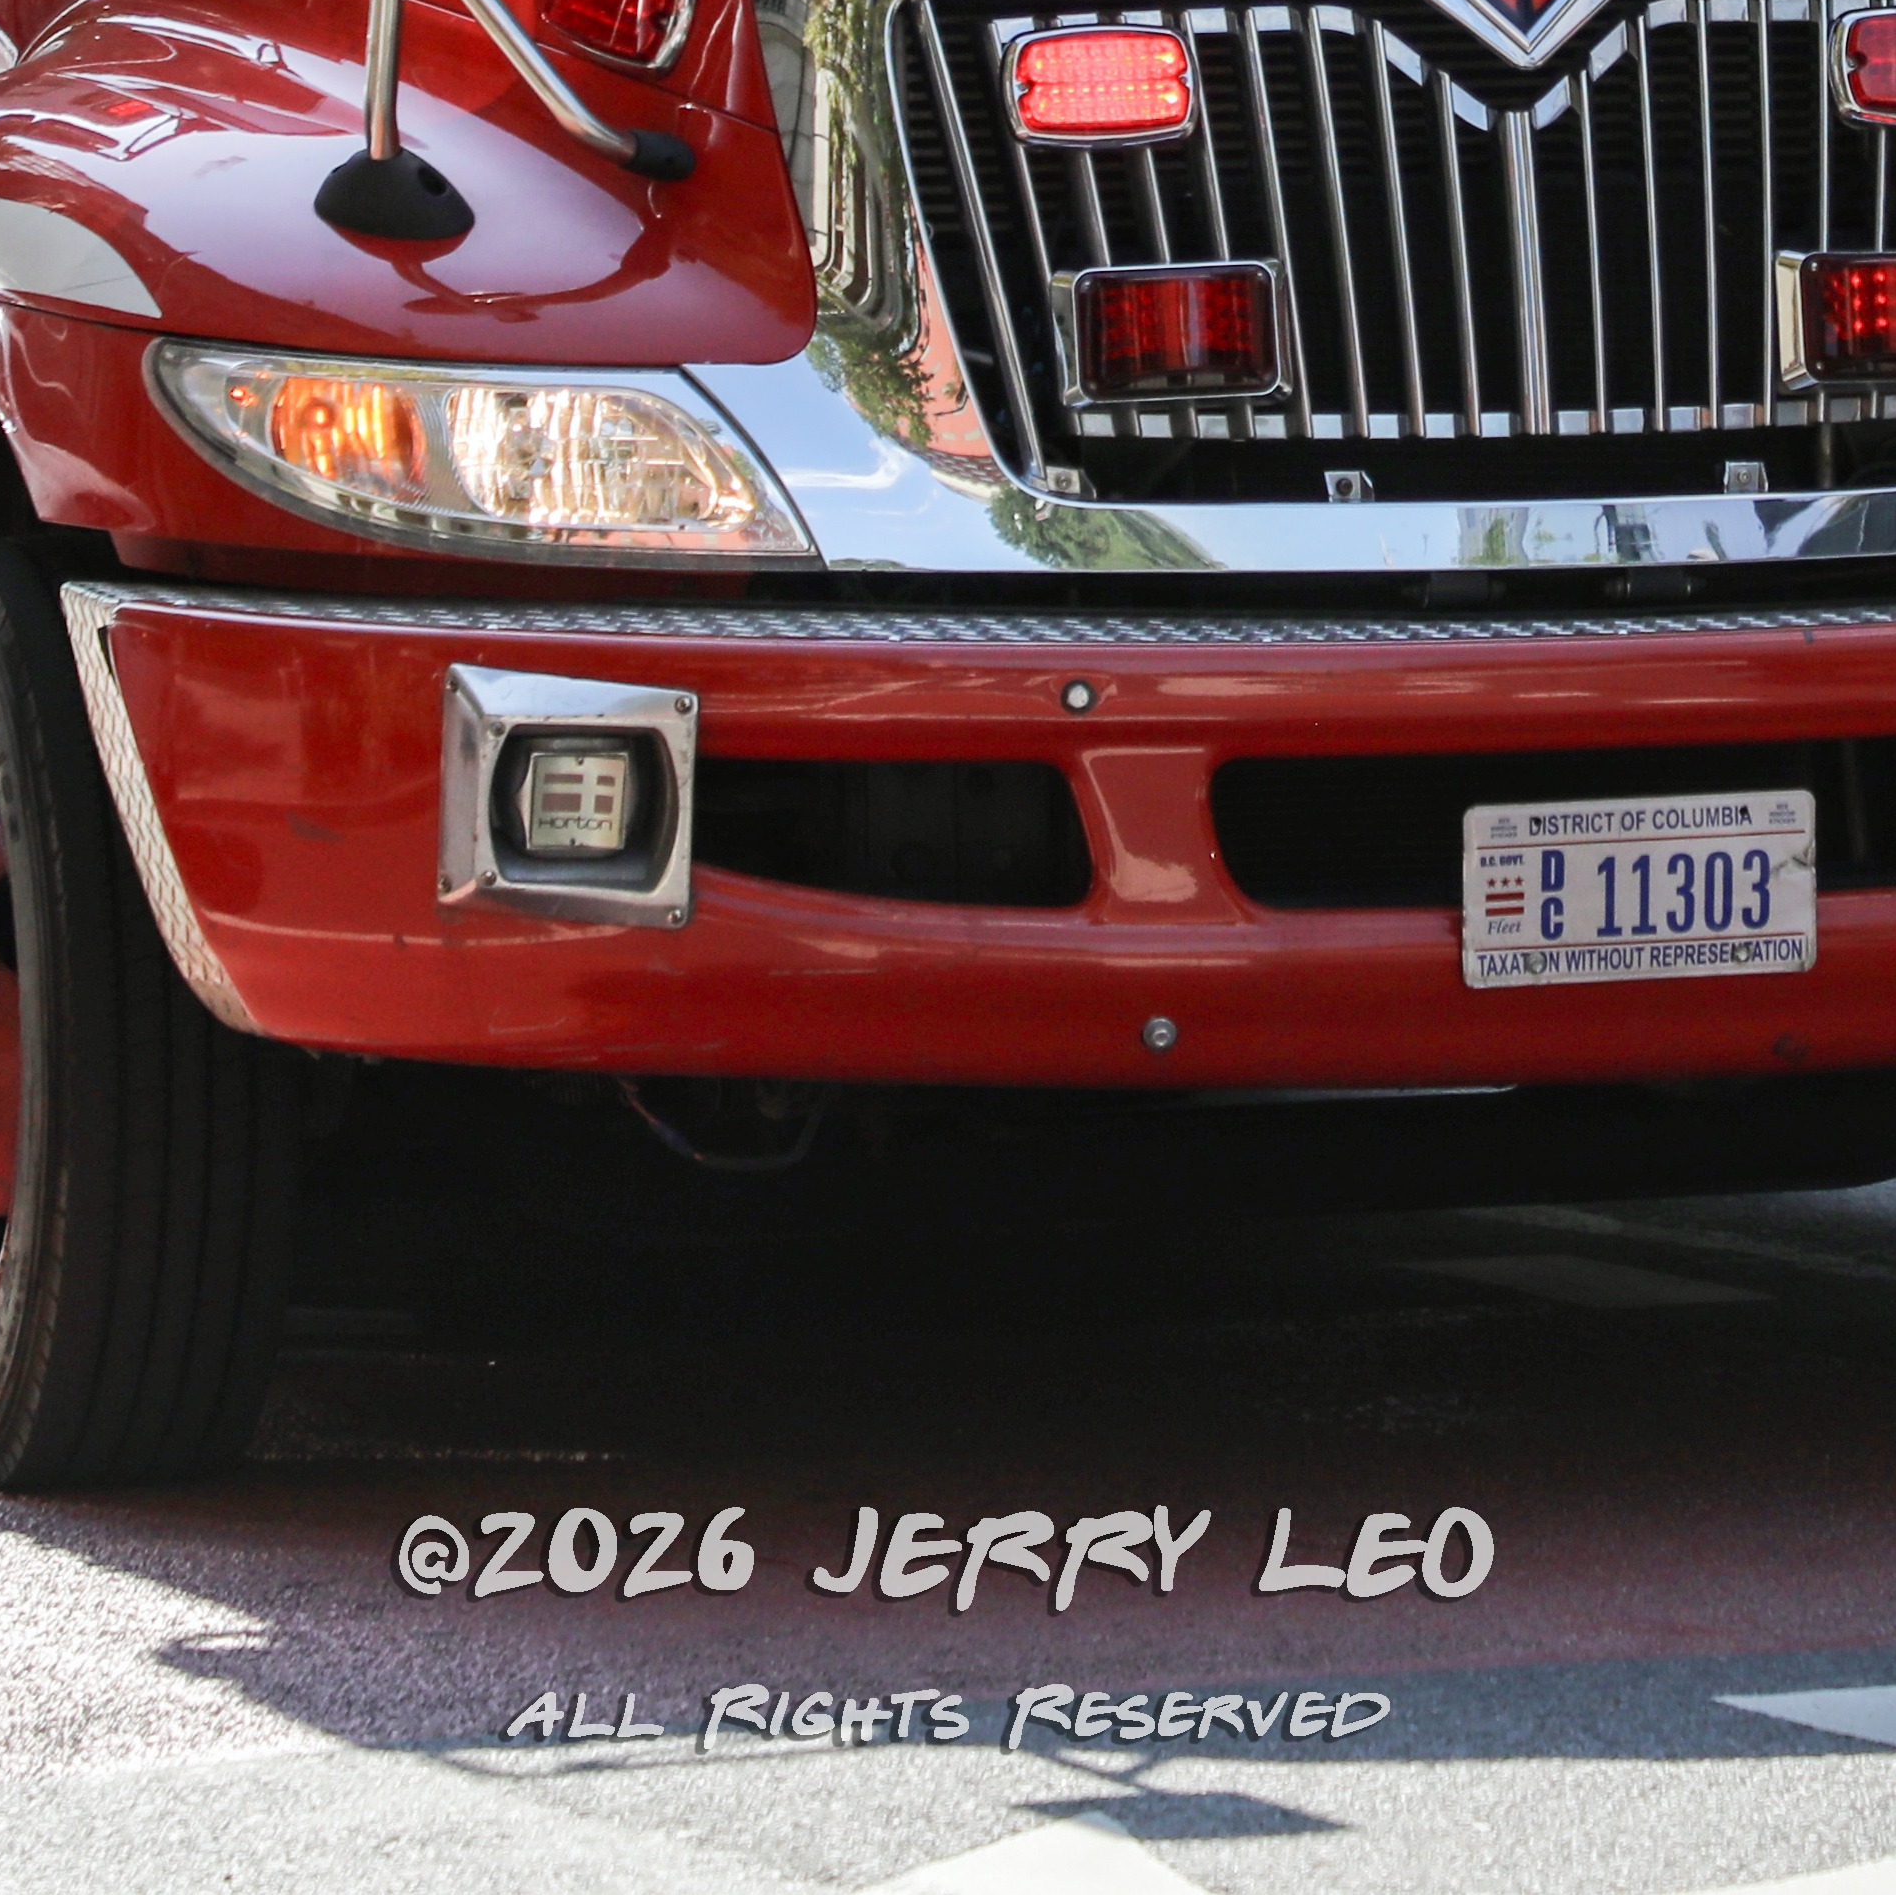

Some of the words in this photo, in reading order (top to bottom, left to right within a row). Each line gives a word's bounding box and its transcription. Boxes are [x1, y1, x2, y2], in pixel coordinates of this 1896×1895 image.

[538, 816, 613, 831] Horton
[1529, 813, 1614, 836] DISTRICT
[1621, 810, 1645, 831] OF
[1652, 805, 1753, 830] COLUMBIA
[1597, 848, 1771, 938] 11303
[1487, 918, 1522, 935] Fleet
[1477, 952, 1560, 977] TAXATON
[1565, 947, 1645, 972] WITHOUT
